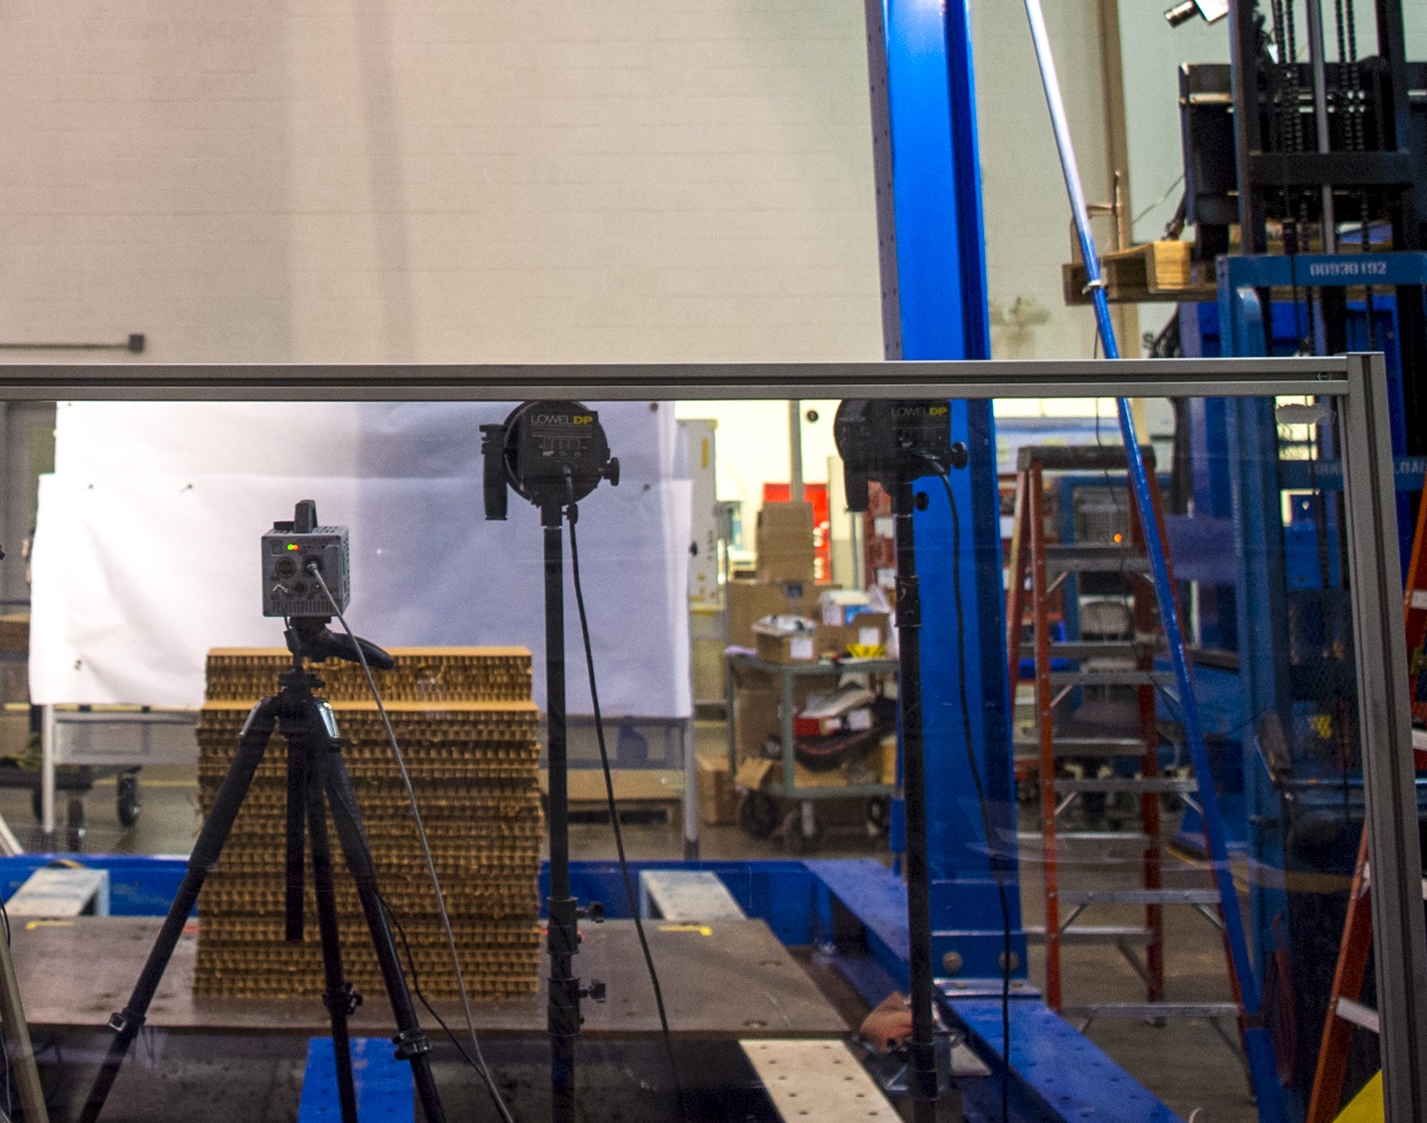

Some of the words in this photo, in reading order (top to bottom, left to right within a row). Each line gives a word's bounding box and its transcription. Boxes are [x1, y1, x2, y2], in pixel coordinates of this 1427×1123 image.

[891, 407, 927, 416] LOWEL
[929, 407, 948, 416] DP
[530, 414, 571, 424] LOWEL
[572, 415, 593, 425] DP
